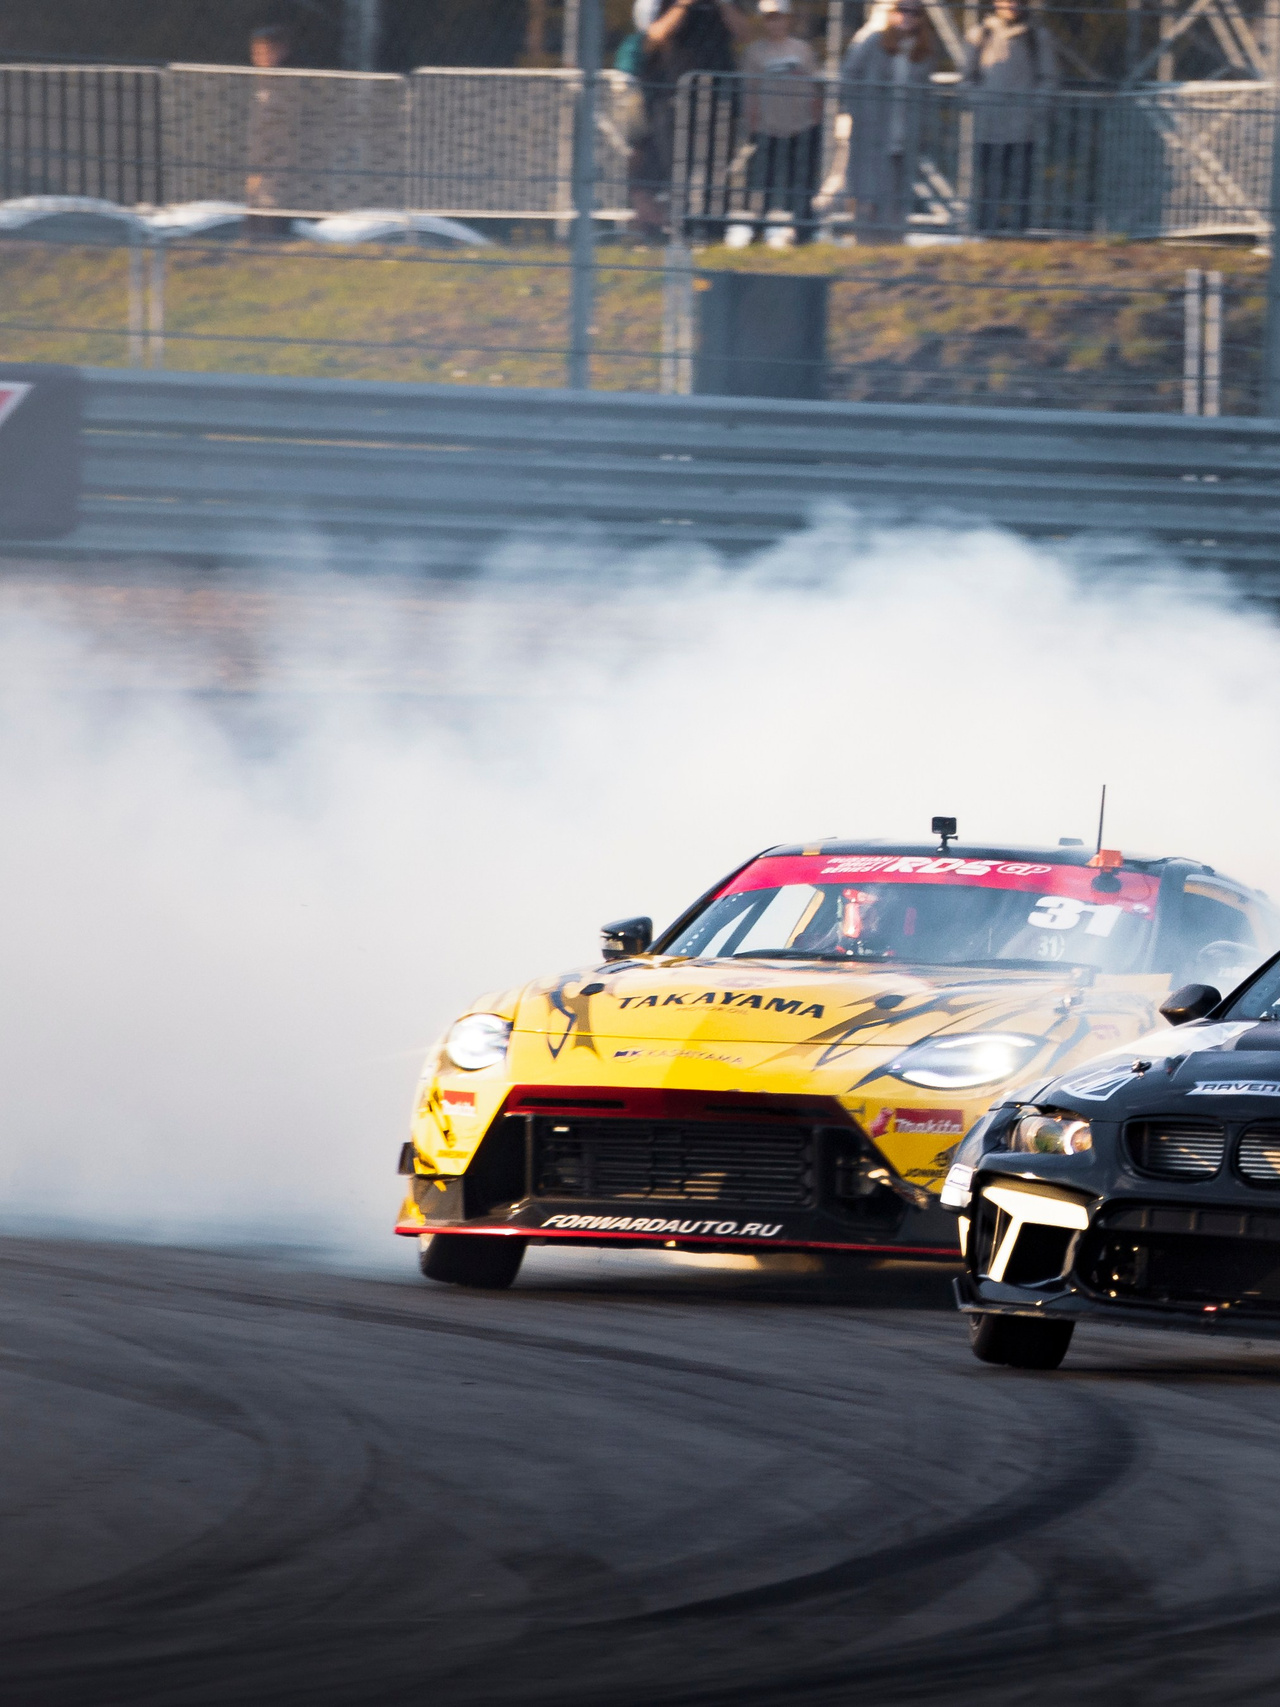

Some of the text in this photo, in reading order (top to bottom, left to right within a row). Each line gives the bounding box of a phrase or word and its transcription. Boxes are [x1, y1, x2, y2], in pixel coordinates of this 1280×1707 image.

[882, 857, 1052, 876] RDS GP
[1027, 896, 1123, 938] 31
[618, 991, 825, 1019] TAKAYAMA
[540, 1214, 783, 1237] FORWARDAUTO.RU
